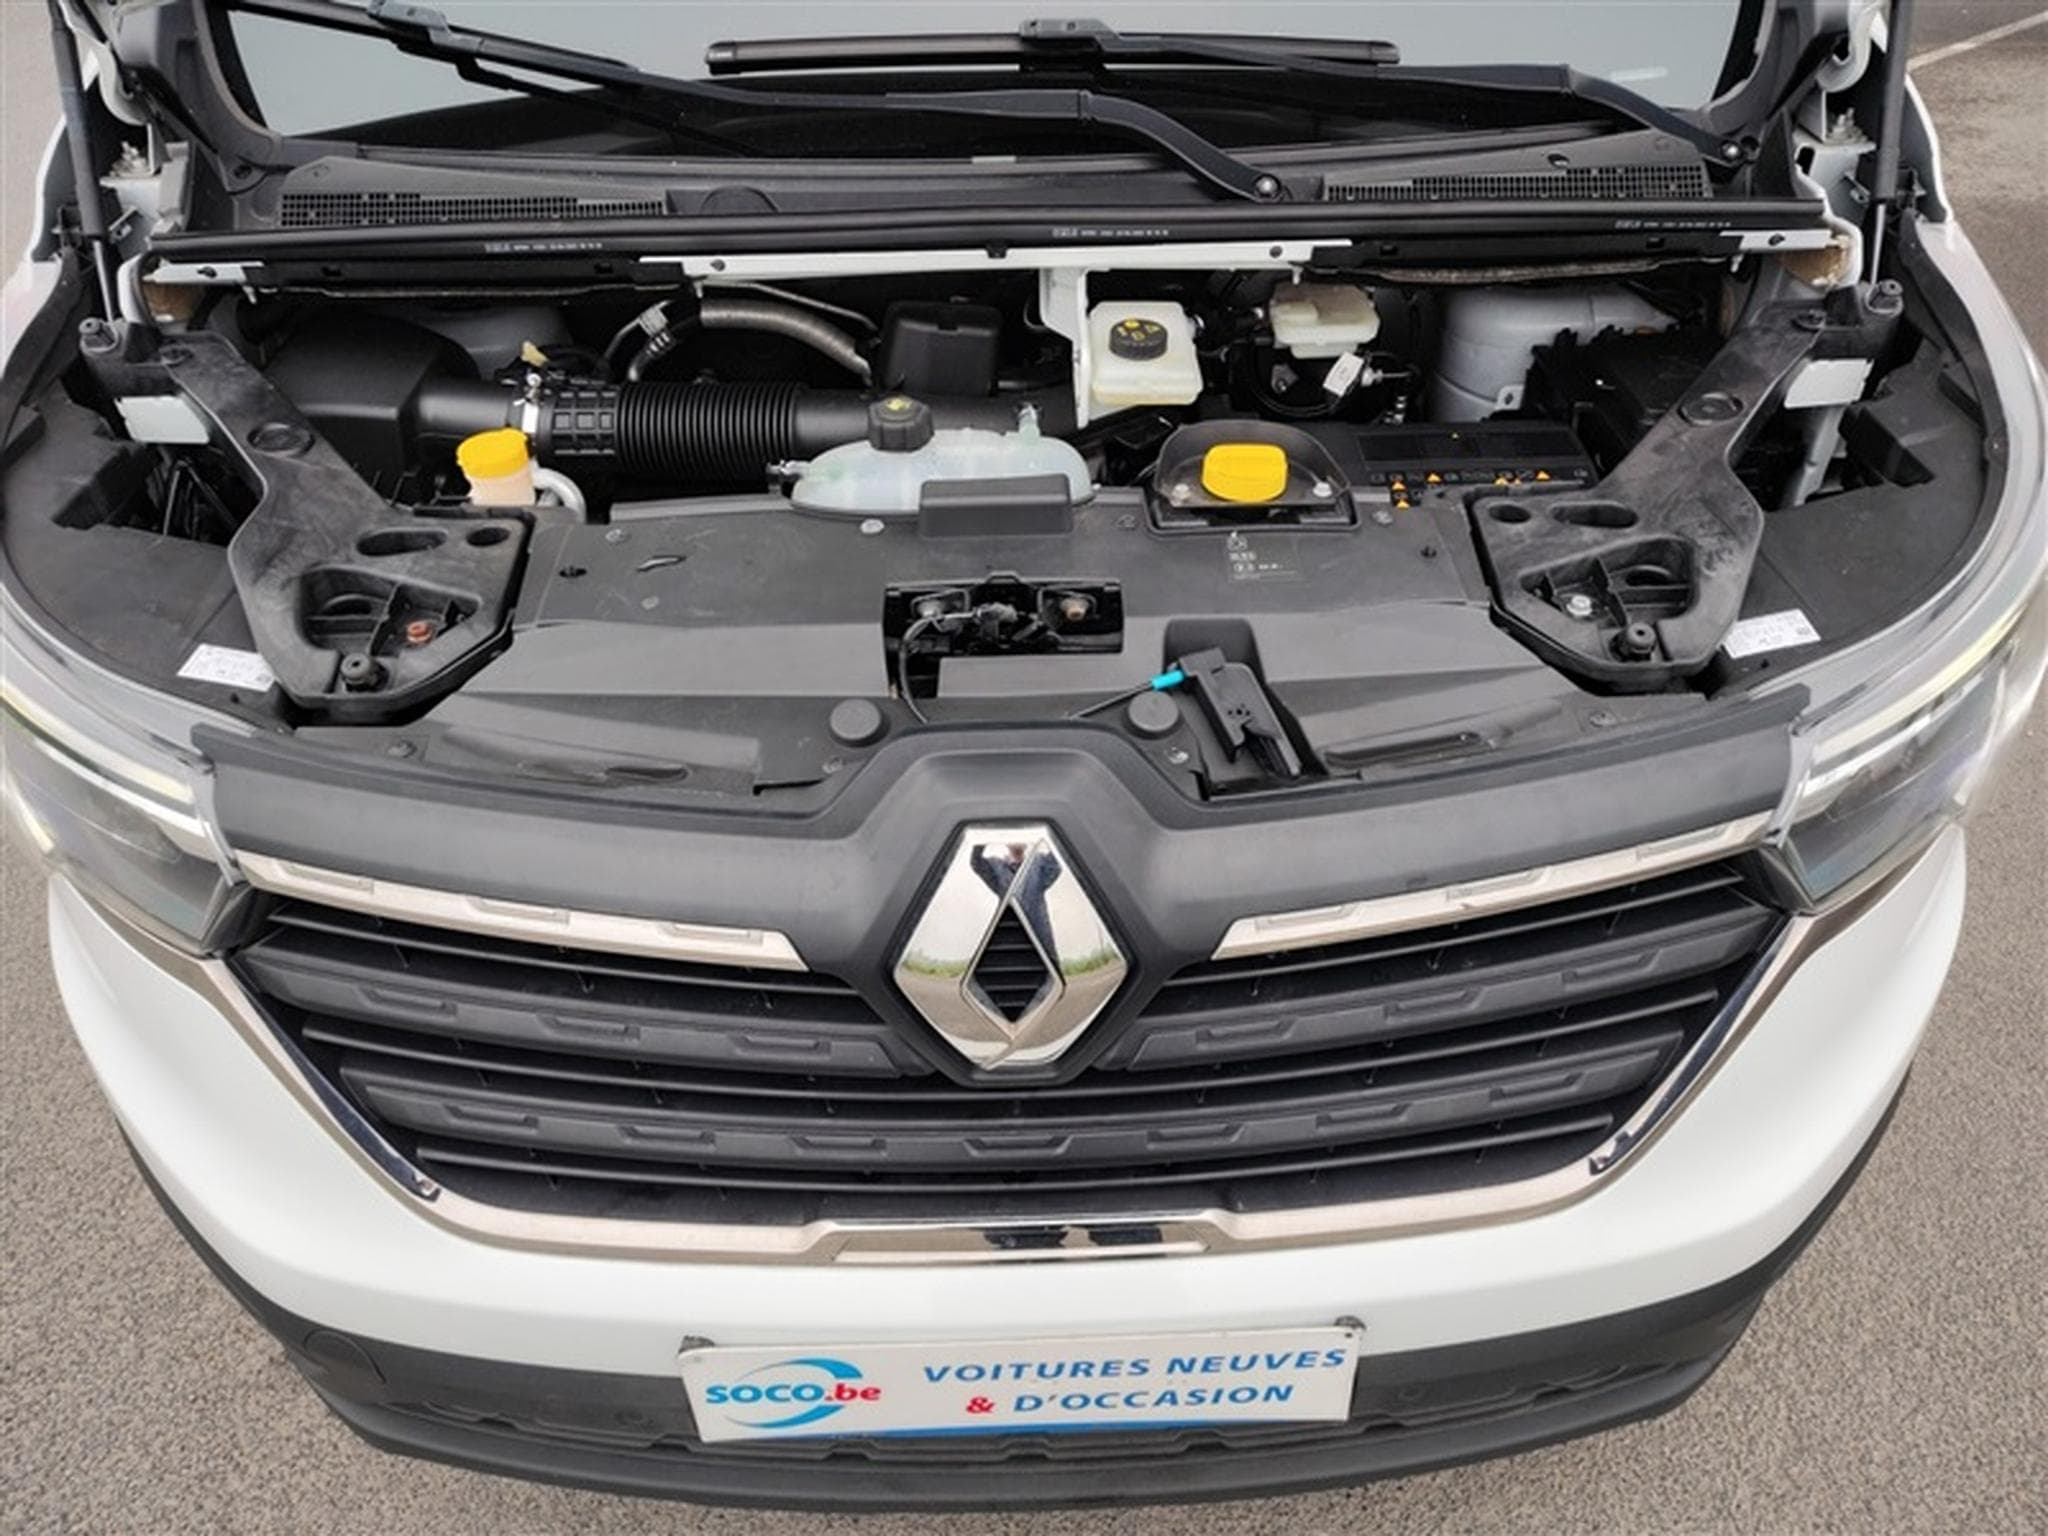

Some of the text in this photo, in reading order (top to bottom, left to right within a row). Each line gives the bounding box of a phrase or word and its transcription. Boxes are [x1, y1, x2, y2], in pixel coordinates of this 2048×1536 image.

[923, 1348, 1346, 1383] VOITURES NEUVES
[705, 1383, 882, 1404] SOCO.be
[966, 1385, 1294, 1414] & D'OCCASION
